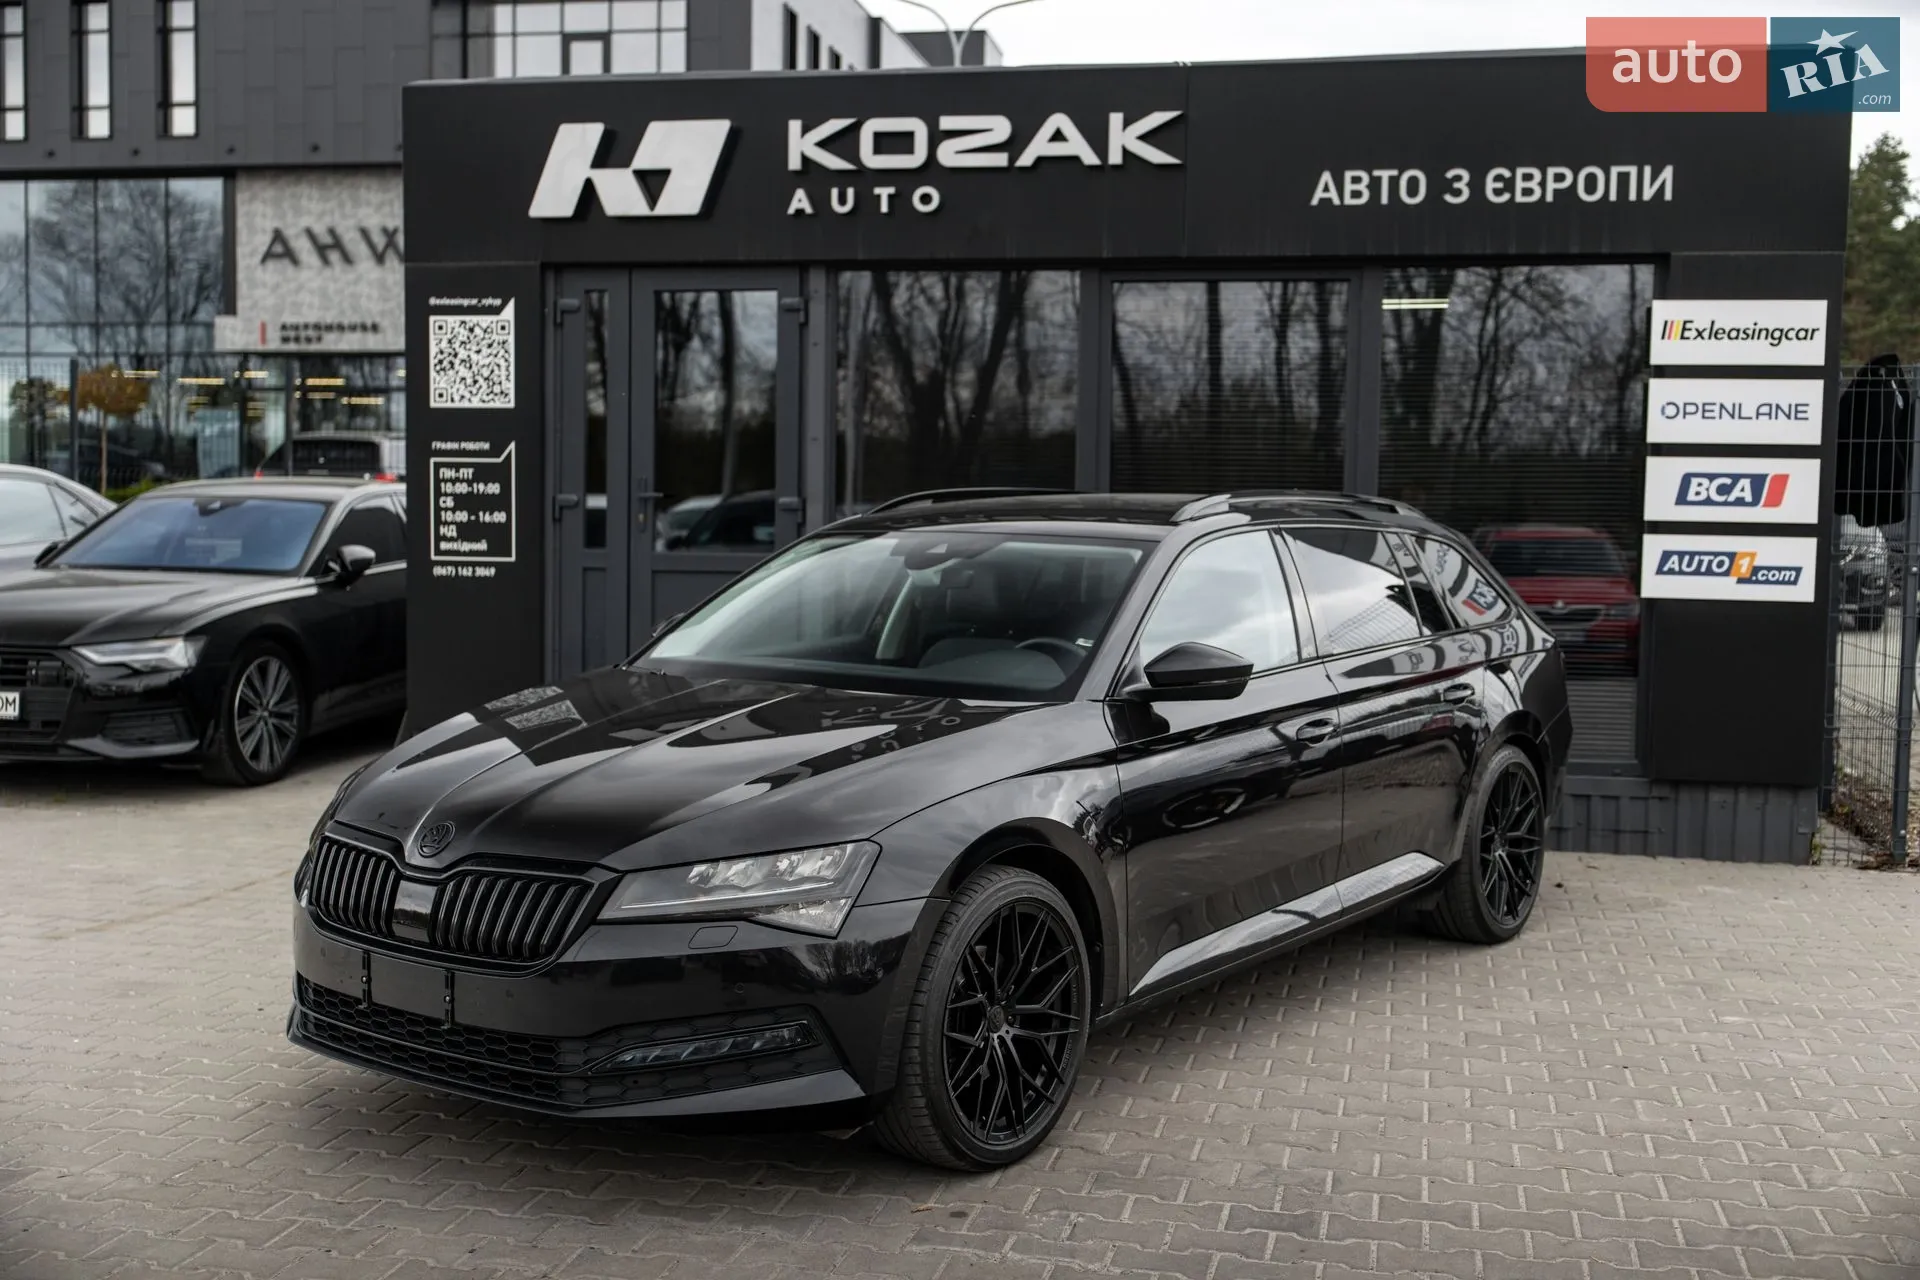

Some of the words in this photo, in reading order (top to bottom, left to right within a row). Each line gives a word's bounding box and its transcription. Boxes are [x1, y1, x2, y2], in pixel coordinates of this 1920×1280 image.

[787, 110, 1184, 171] KOZAK
[1310, 168, 1427, 206] АВТО
[1443, 168, 1471, 204] З
[1485, 165, 1674, 203] ЄВРОПИ
[787, 185, 941, 215] AUTO
[1679, 320, 1820, 347] Exleasingcar
[1660, 401, 1810, 421] OPENLANE
[439, 467, 475, 480] ПН-ПТ
[1686, 477, 1753, 503] BCA
